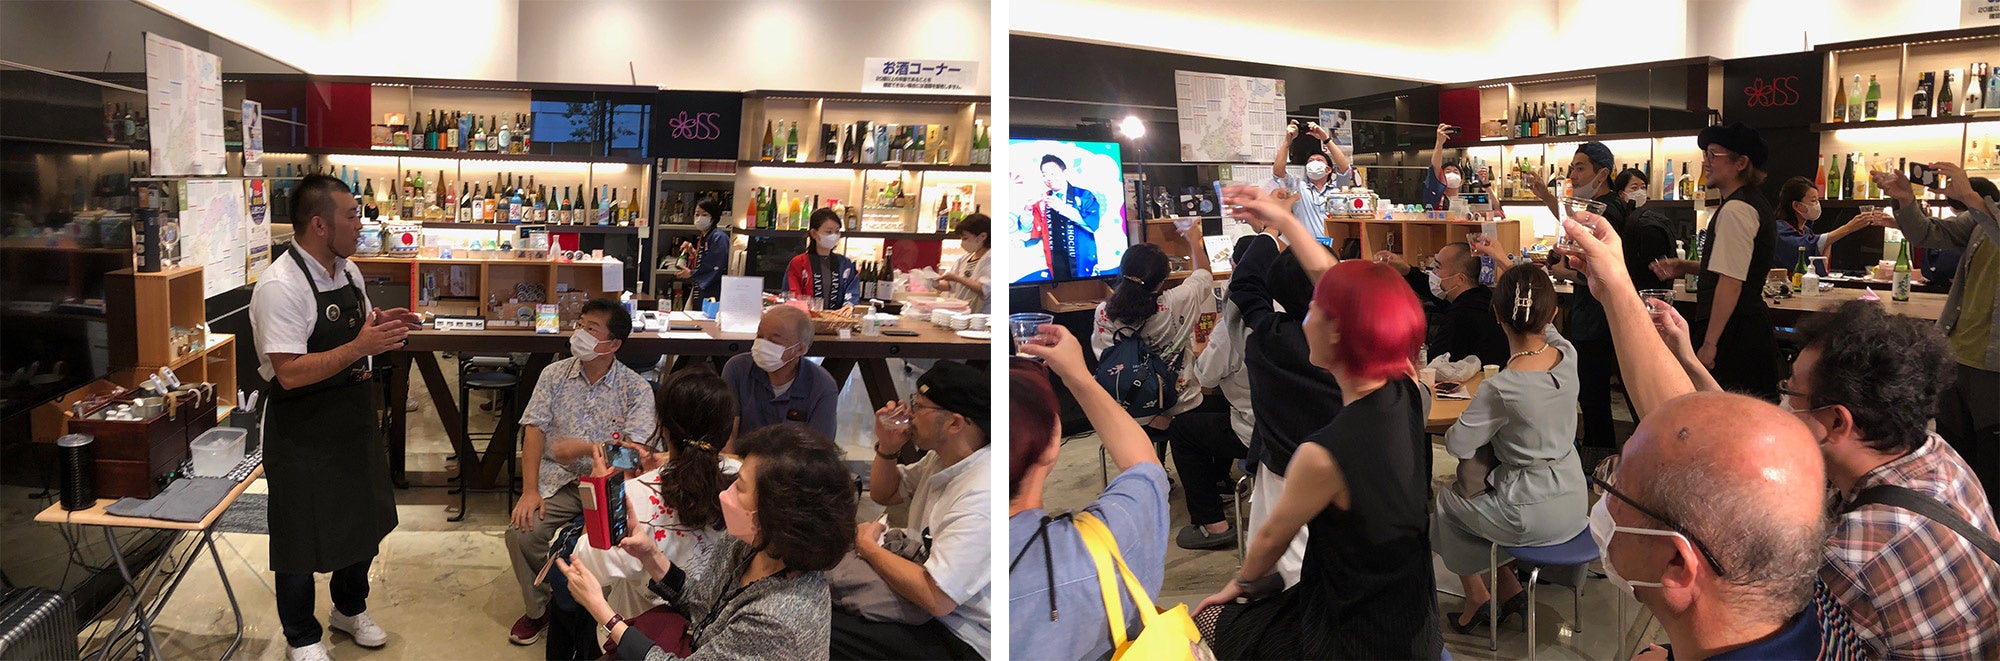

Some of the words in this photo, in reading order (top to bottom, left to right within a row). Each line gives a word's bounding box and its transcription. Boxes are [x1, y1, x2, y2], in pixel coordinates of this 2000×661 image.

[882, 61, 962, 76] お酒コーナー
[1066, 224, 1076, 257] SHOCHU
[830, 271, 839, 300] JAPAN
